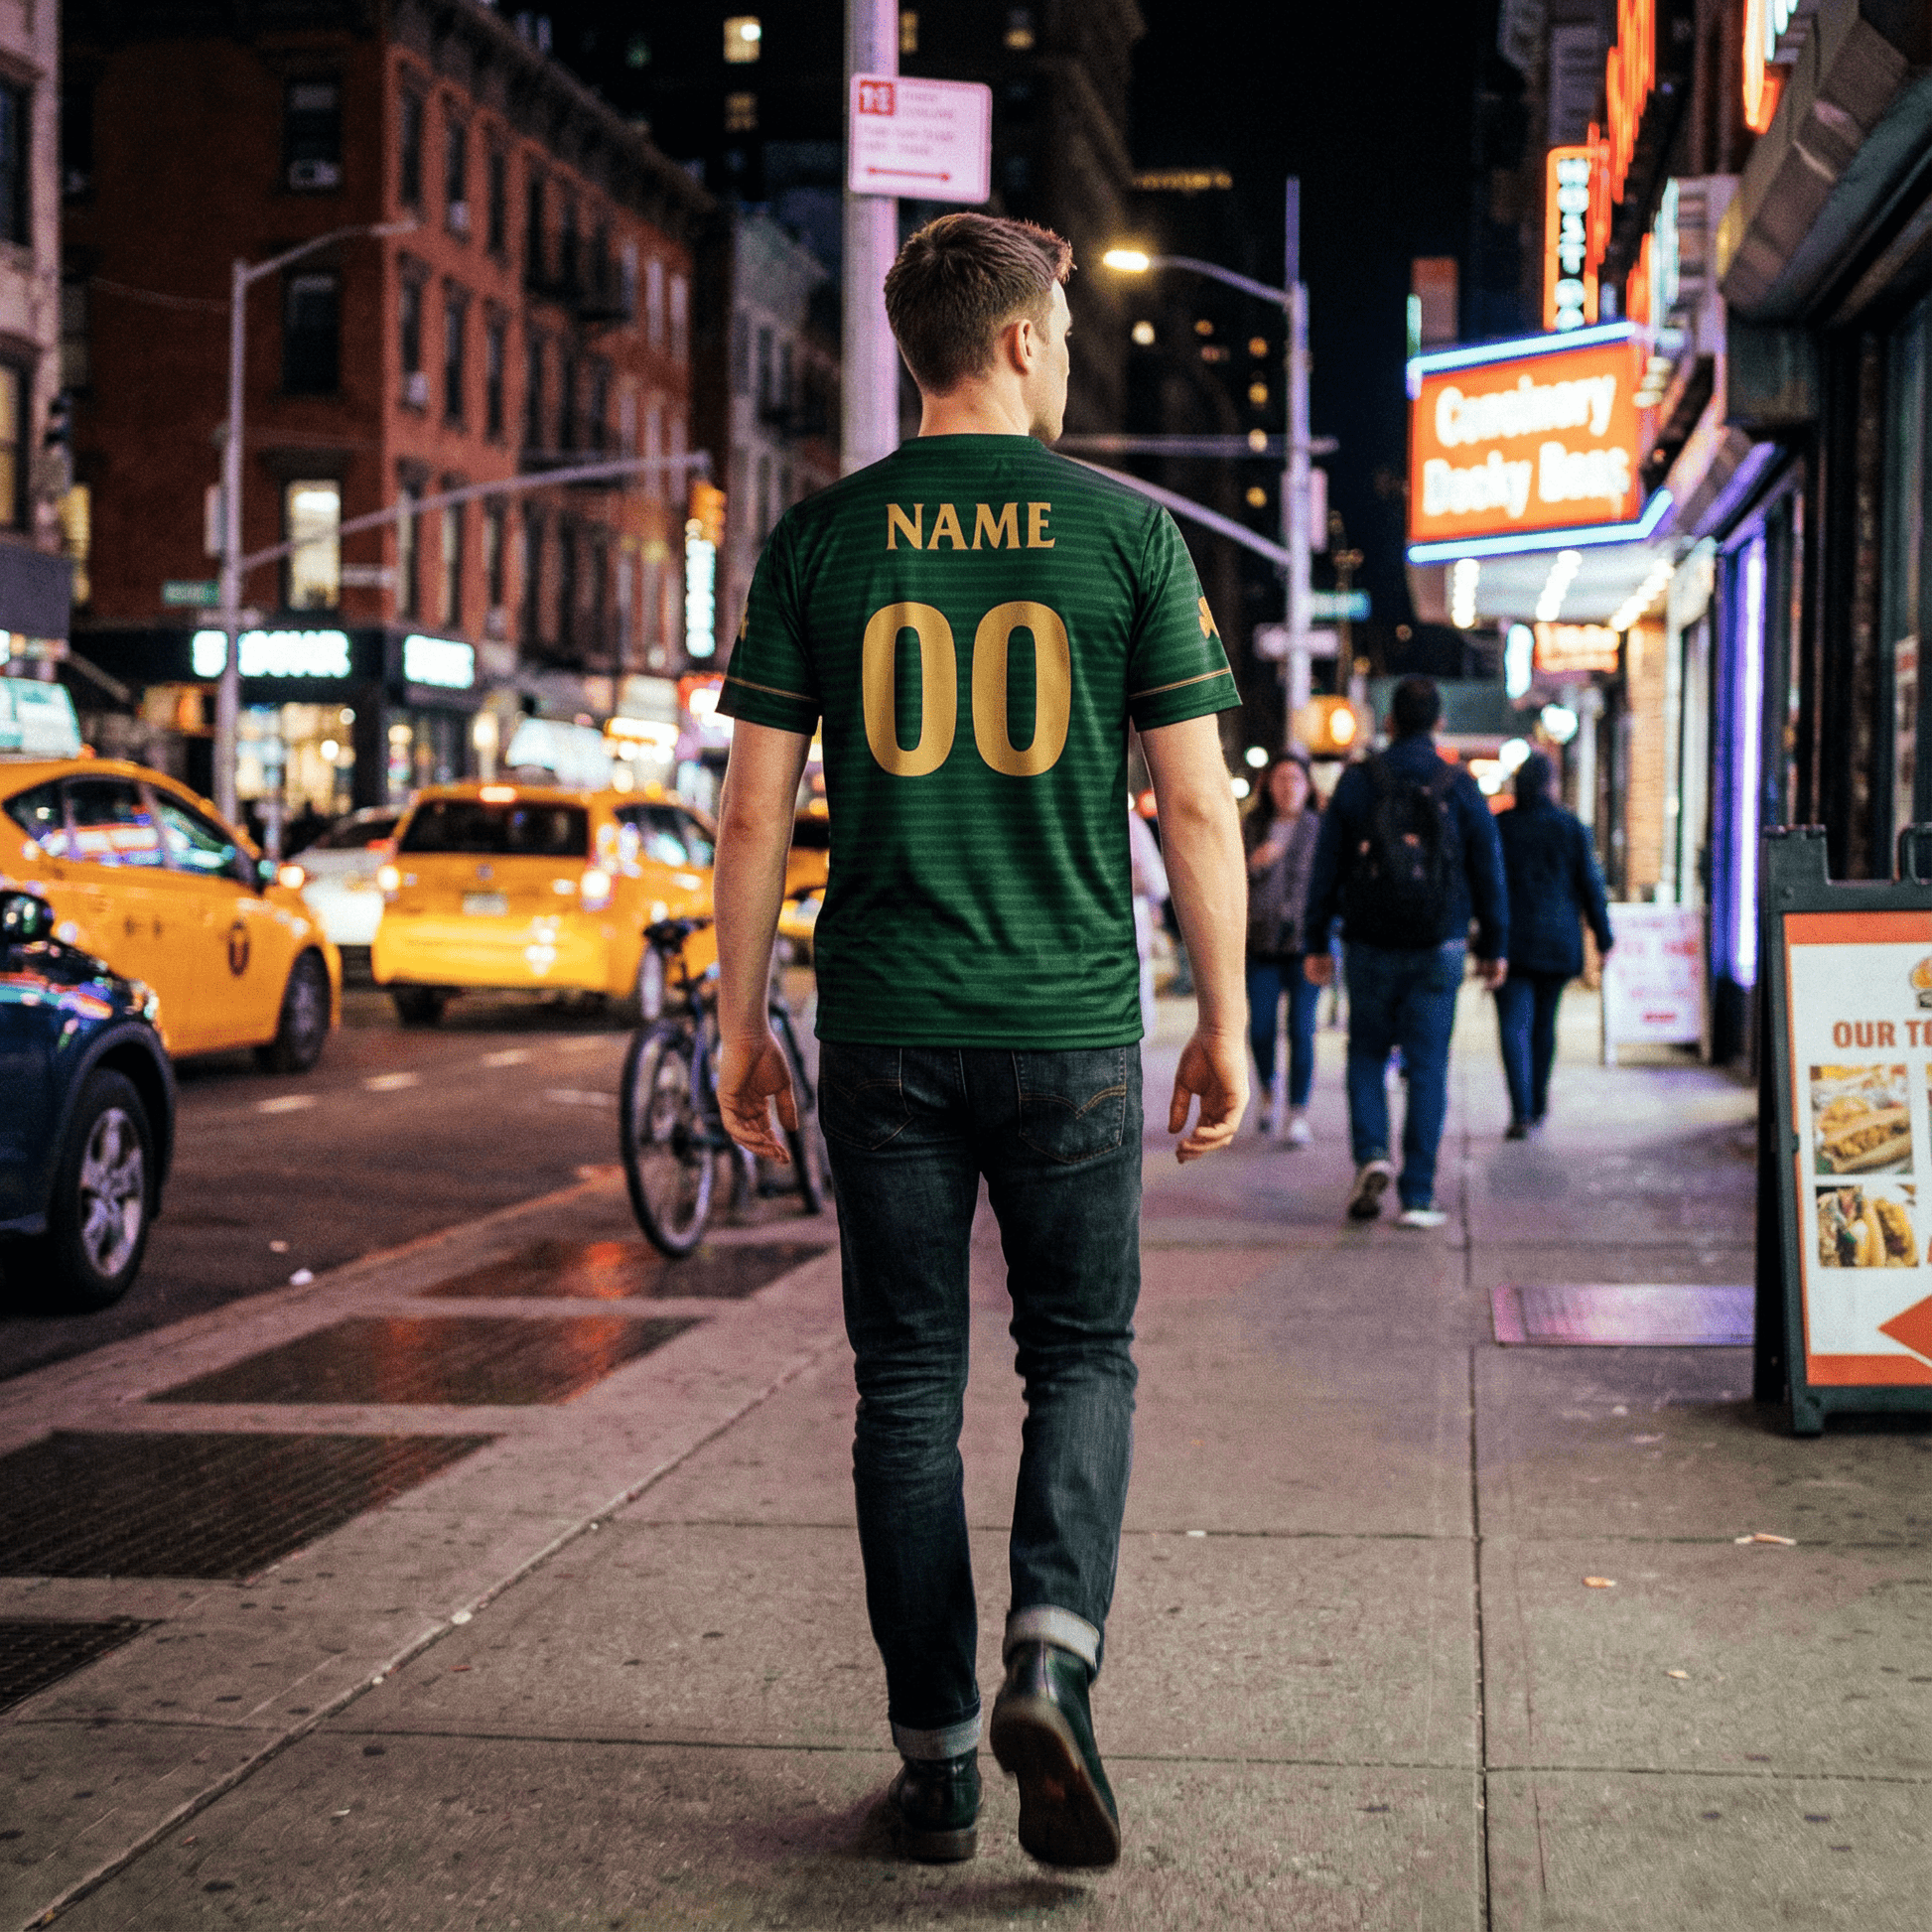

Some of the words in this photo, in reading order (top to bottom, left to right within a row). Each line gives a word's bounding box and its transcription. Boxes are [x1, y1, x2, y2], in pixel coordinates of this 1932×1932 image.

[886, 501, 1055, 550] NAME
[862, 601, 1072, 777] 00
[1832, 1021, 1896, 1048] OUR
